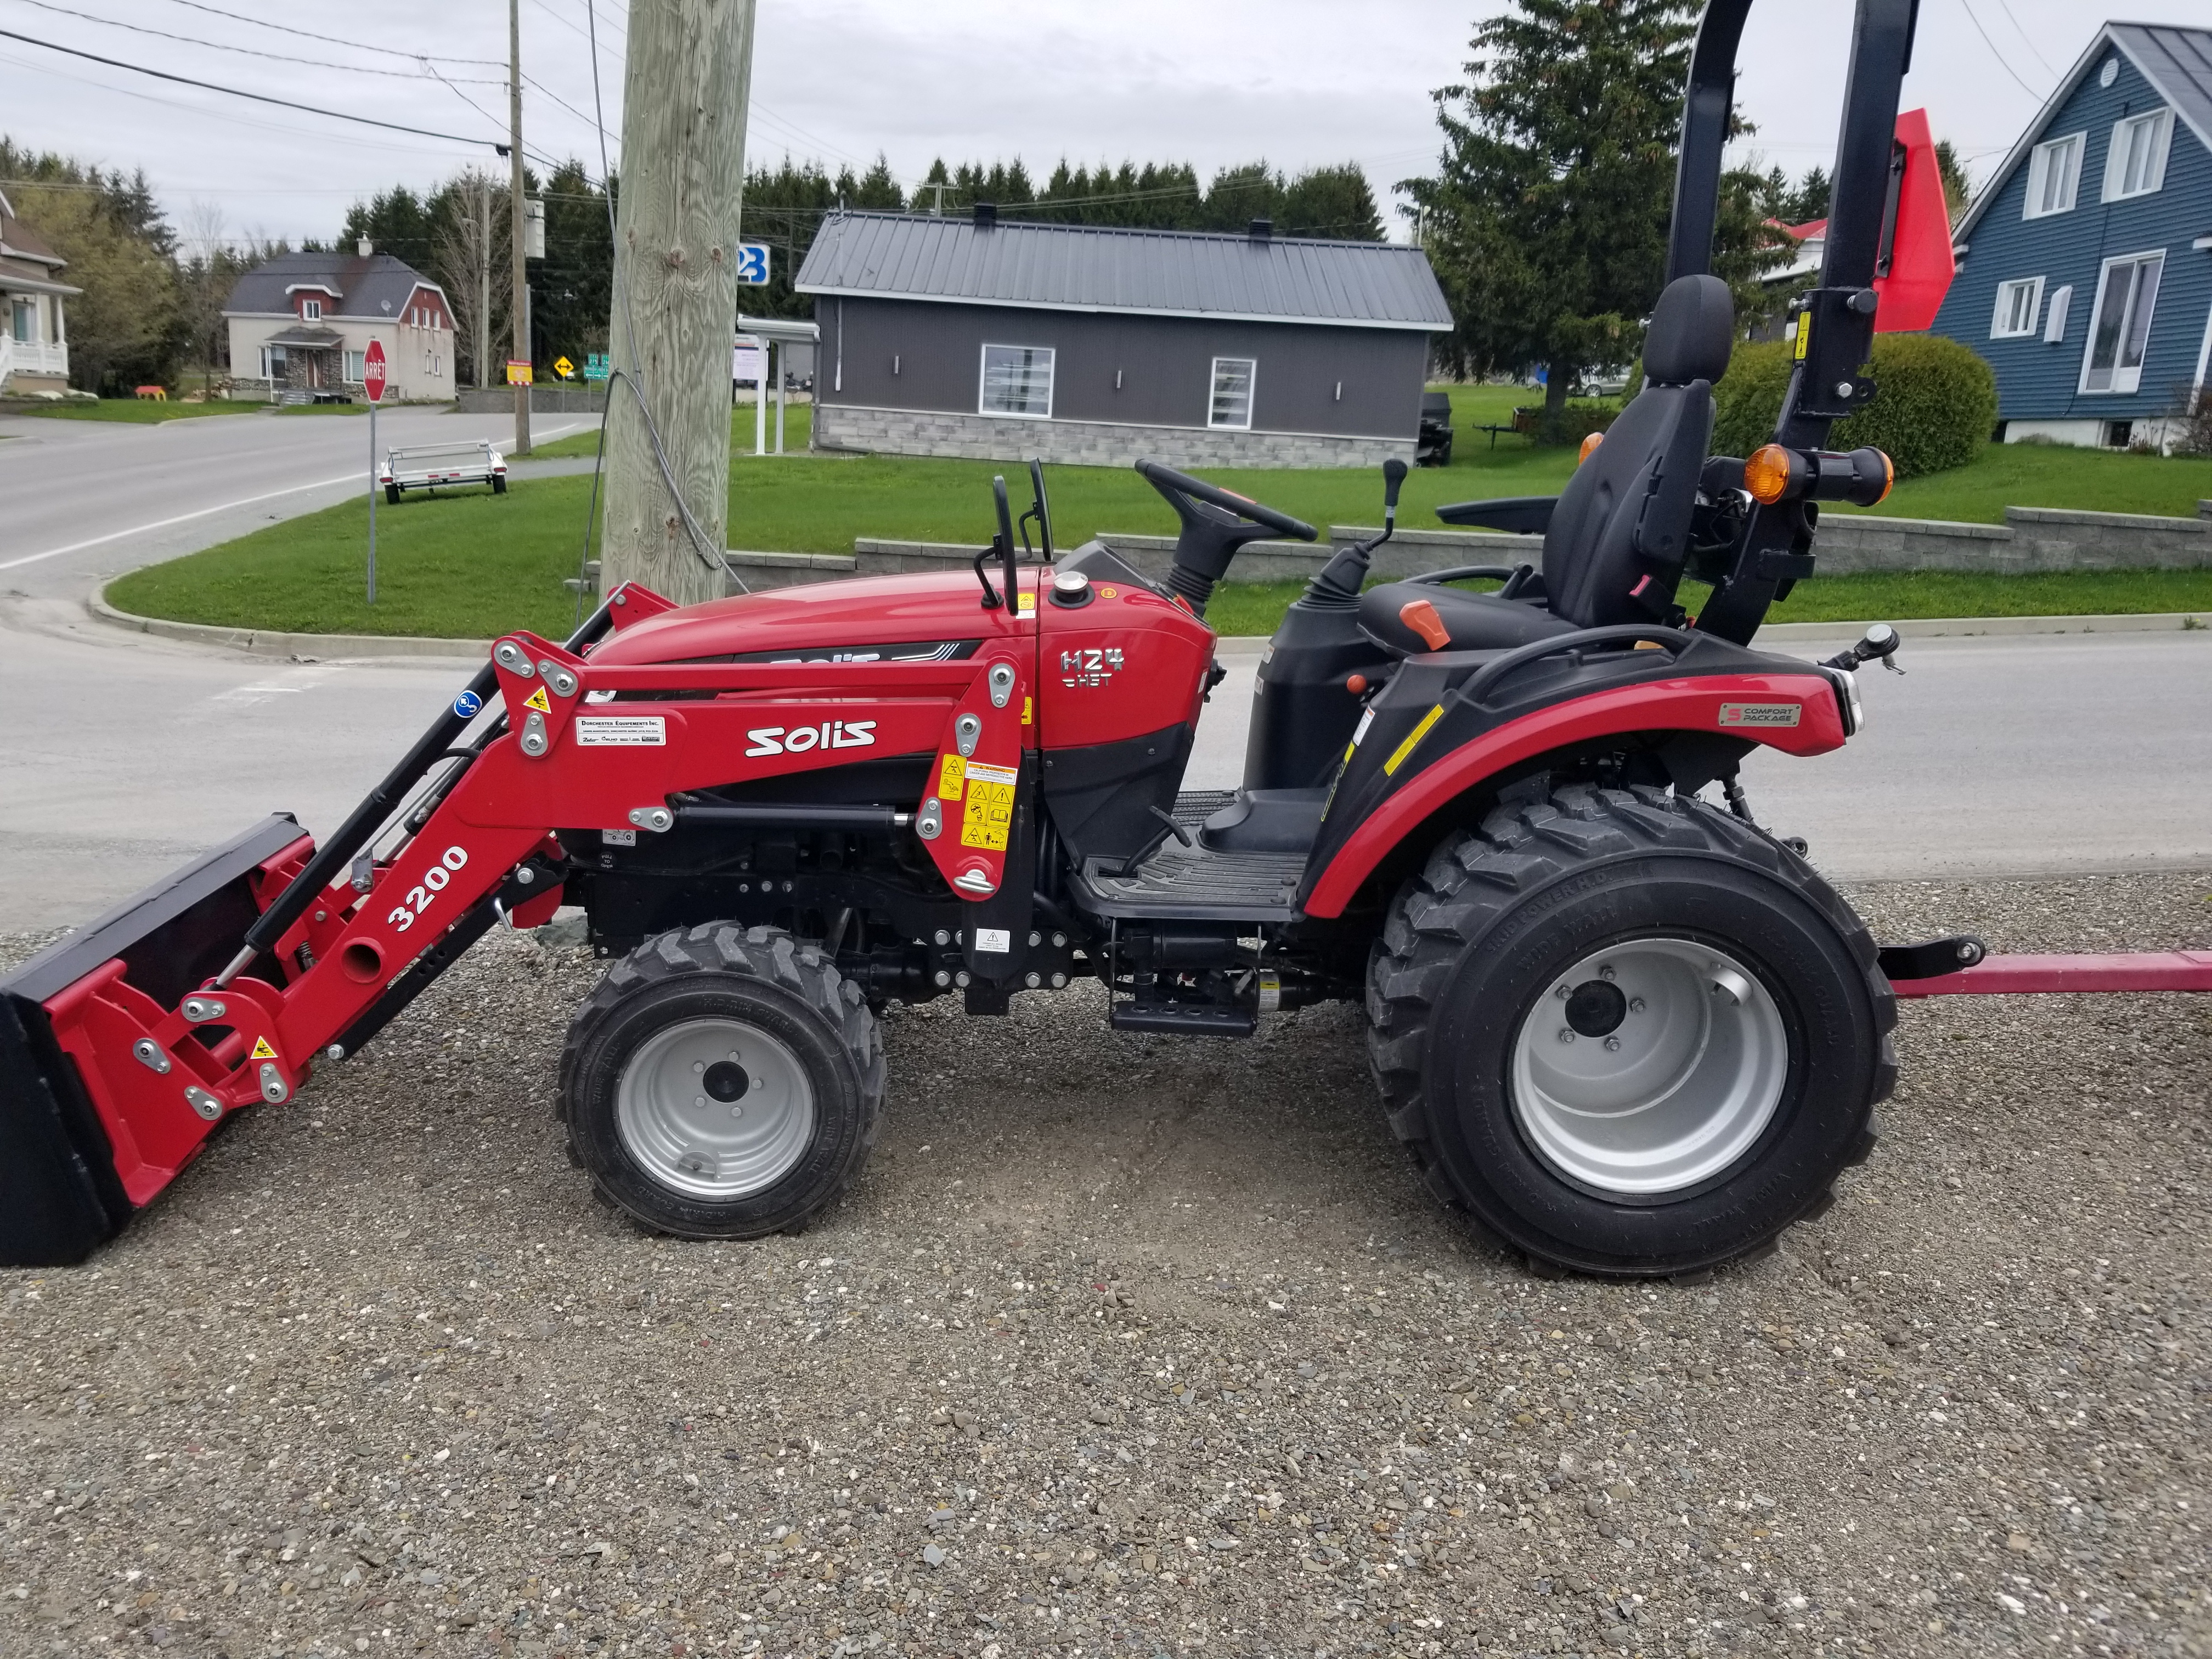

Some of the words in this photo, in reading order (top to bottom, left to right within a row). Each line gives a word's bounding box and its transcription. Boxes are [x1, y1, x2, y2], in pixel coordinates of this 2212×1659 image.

[365, 359, 385, 380] ARRÊT
[1061, 649, 1124, 673] H24
[1077, 673, 1112, 687] HST
[388, 845, 469, 933] 3200
